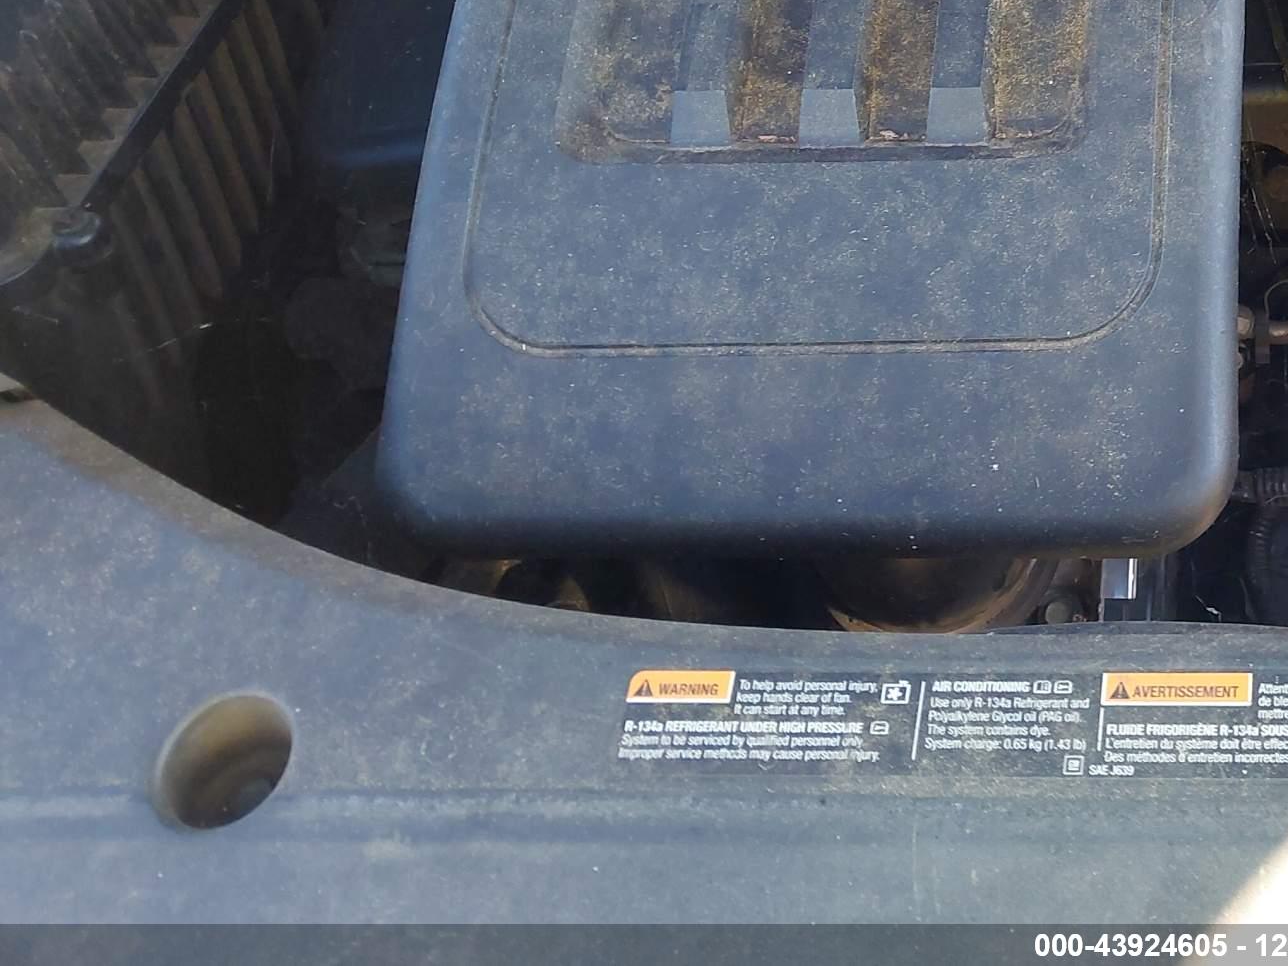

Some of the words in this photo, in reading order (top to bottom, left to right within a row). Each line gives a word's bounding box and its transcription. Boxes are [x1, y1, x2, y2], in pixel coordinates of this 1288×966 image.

[658, 683, 719, 695] WARNING
[740, 679, 750, 690] To
[753, 679, 774, 693] help
[776, 680, 802, 691] avoid
[804, 681, 847, 695] personal
[932, 681, 950, 692] AIR
[952, 681, 1031, 693] CONDITIONING
[1132, 685, 1239, 698] AVERTISSEMENT
[736, 692, 761, 704] keep
[763, 692, 793, 703] hands
[795, 693, 818, 703] clear
[821, 693, 832, 703] of
[834, 693, 852, 703] fan.
[930, 697, 949, 708] Use
[951, 697, 973, 710] only
[974, 697, 1012, 709] R-134a
[1013, 698, 1069, 711] Refrigerant
[1070, 698, 1090, 709] and
[1258, 696, 1272, 707] de
[743, 706, 761, 715] can
[764, 705, 787, 715] start
[789, 705, 799, 715] at
[801, 707, 820, 718] any
[822, 705, 846, 715] time.
[928, 711, 990, 724] Polyalkylene
[991, 711, 1022, 724] Glycol
[1024, 711, 1037, 722] oil
[624, 720, 663, 732] R-134a
[665, 720, 739, 732] REFRIGERANT
[740, 721, 777, 733] UNDER
[779, 721, 807, 733] HIGH
[927, 724, 946, 735] The
[948, 725, 984, 737] system
[985, 725, 1028, 736] contains
[1029, 725, 1050, 737] dye.
[1106, 724, 1145, 736] FLUIDE
[1146, 722, 1218, 736] FRIGORIGÈNE
[1220, 724, 1259, 736] R-134a
[621, 734, 659, 747] System
[661, 735, 672, 745] to
[673, 735, 687, 745] be
[688, 735, 731, 746] serviced
[732, 735, 746, 747] by
[747, 735, 789, 747] qualified
[791, 736, 840, 749] personnel
[924, 737, 962, 750] System
[1003, 738, 1027, 750] 0.65
[1029, 738, 1042, 752] kg
[1044, 739, 1071, 752] (1.43
[1073, 738, 1086, 751] lb)
[1105, 738, 1158, 750] L'entretien
[1159, 739, 1174, 750] du
[1175, 738, 1218, 752] système
[1220, 738, 1239, 750] doit
[1241, 738, 1262, 750] être
[618, 747, 664, 760] Improper
[665, 749, 702, 759] service
[749, 751, 771, 762] may
[773, 751, 803, 761] cause
[804, 750, 848, 763] personal
[1103, 751, 1125, 763] Des
[1126, 751, 1177, 763] méthodes
[1089, 765, 1109, 775] SAE
